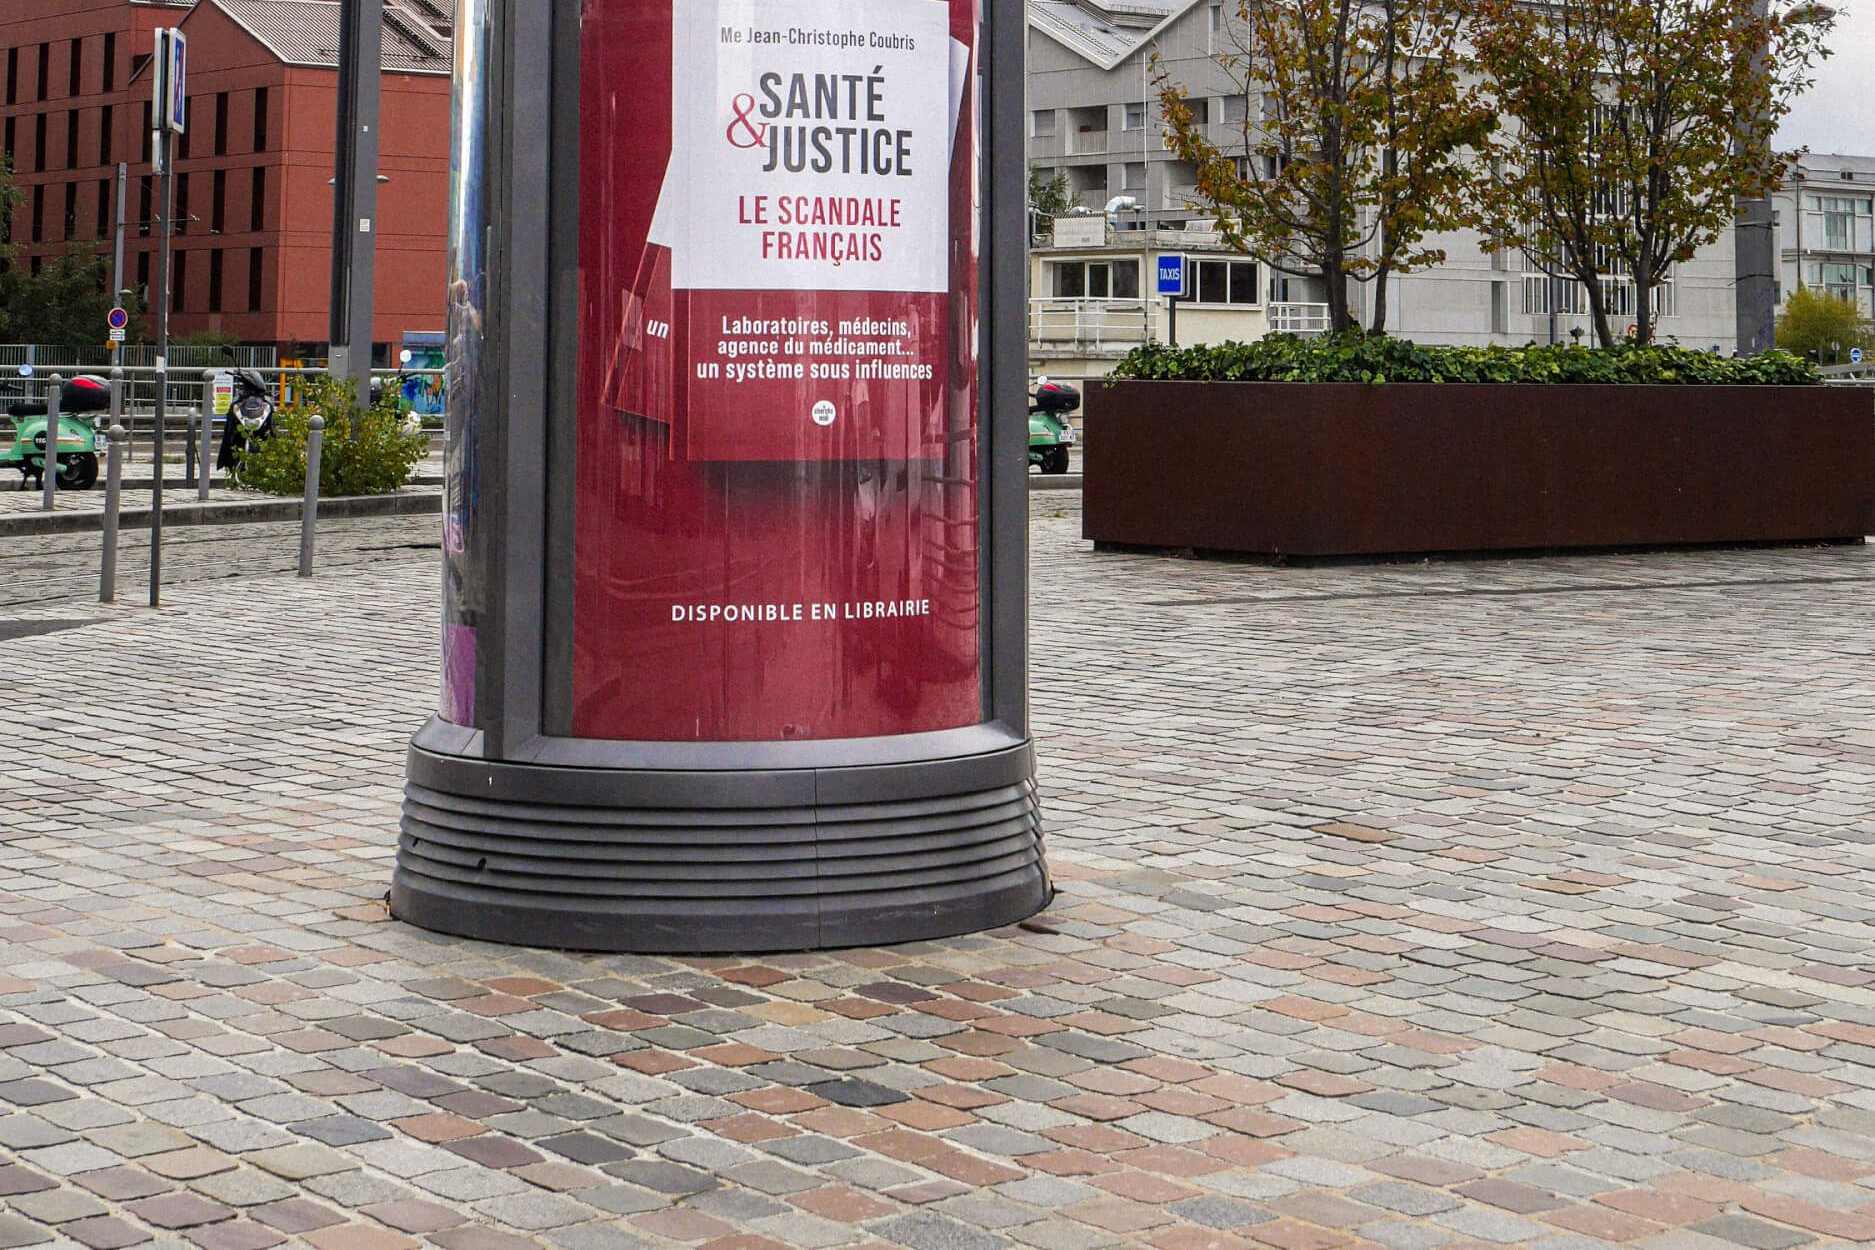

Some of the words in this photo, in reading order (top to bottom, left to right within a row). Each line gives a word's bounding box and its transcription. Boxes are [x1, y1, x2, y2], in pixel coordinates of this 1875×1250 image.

[720, 26, 742, 44] Me
[747, 27, 865, 49] Jean-Christophe
[869, 31, 915, 51] Coubris
[759, 65, 885, 122] SANTÉ
[726, 93, 770, 149] &
[762, 125, 913, 176] JUSTICE
[739, 195, 769, 225] LE
[778, 196, 901, 227] SCANDALE
[762, 231, 882, 267] FRANÇAIS
[1160, 268, 1180, 280] TAXIS
[646, 319, 669, 340] un
[722, 315, 834, 338] Laboratoires,
[839, 317, 912, 339] médecins,
[717, 339, 779, 358] agence
[784, 337, 804, 355] du
[809, 337, 914, 356] médicament...
[697, 362, 720, 379] un
[725, 359, 804, 383] système
[810, 362, 850, 380] sous
[855, 359, 933, 380] influences
[671, 603, 803, 622] DISPONIBLE
[811, 602, 837, 620] EN
[845, 599, 930, 619] LIBRAIRIE
